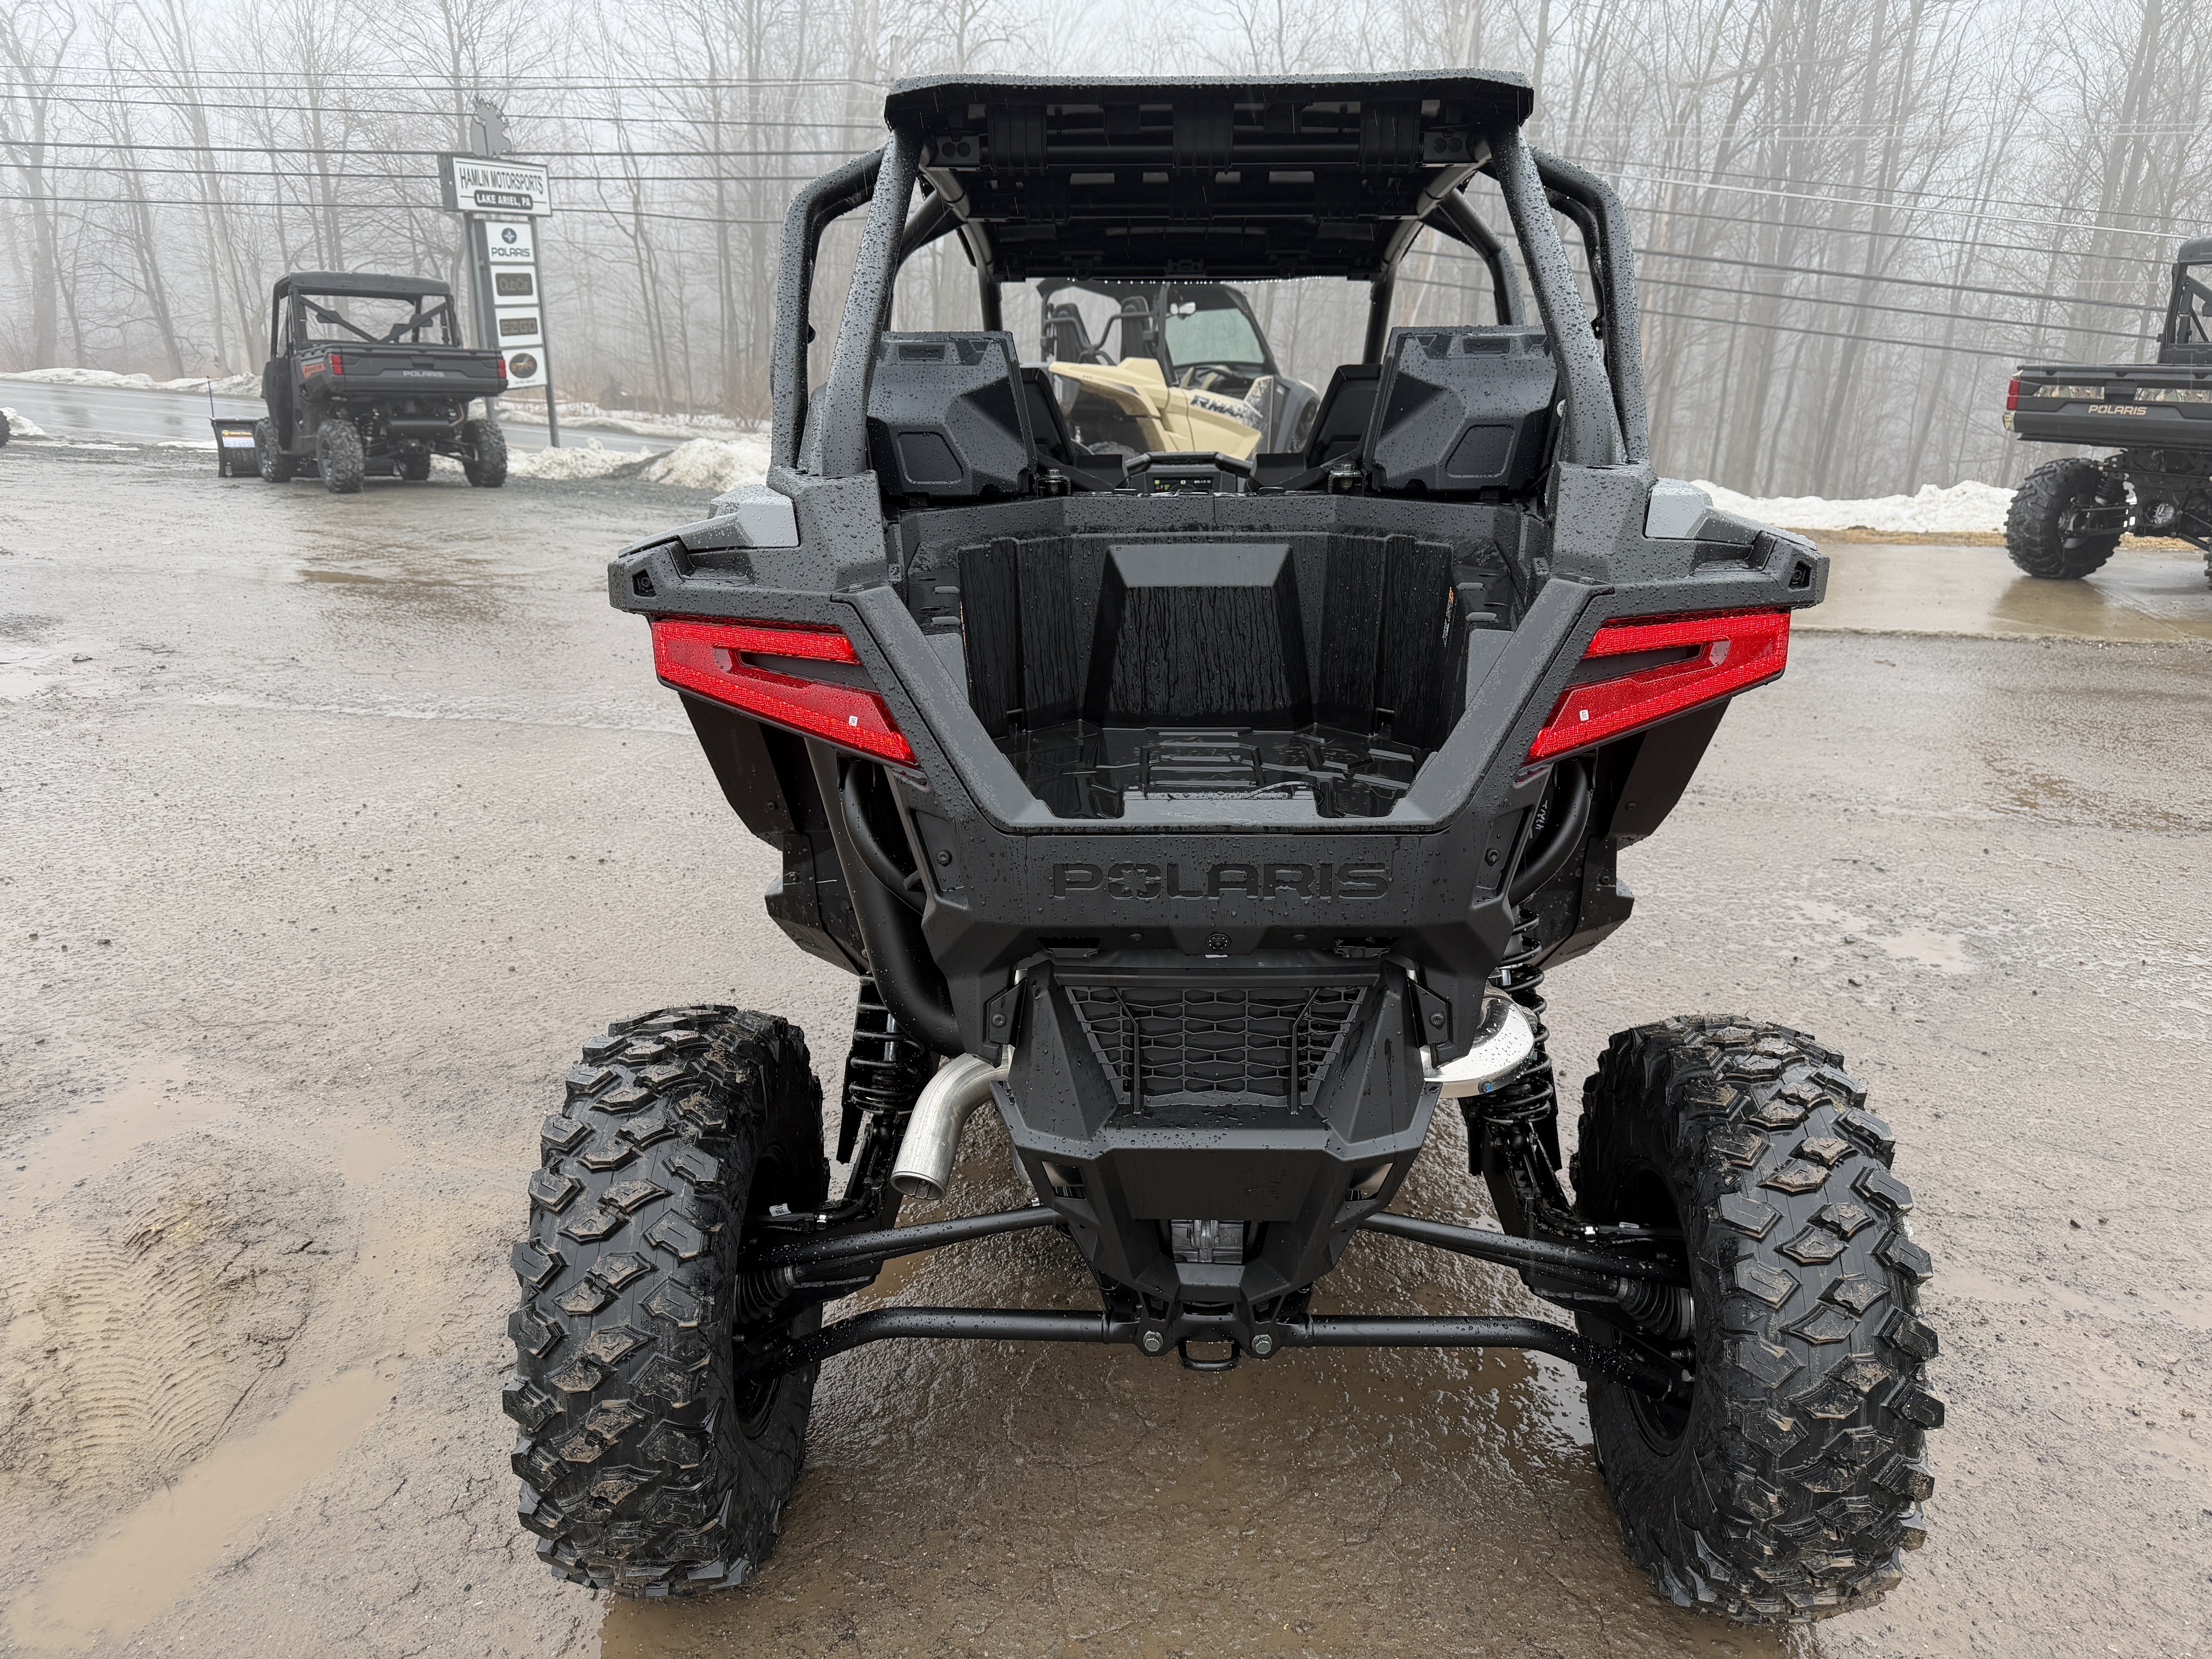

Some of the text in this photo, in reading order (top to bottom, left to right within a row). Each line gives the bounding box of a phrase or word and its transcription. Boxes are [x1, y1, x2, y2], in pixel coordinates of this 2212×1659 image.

[459, 167, 543, 195] HAMLIN MOTORSPORTS
[476, 194, 496, 204] LAKE
[521, 197, 531, 207] PA
[491, 247, 530, 257] POLARIS
[2088, 405, 2147, 416] POLARIS
[1053, 863, 1389, 900] POLARIS
